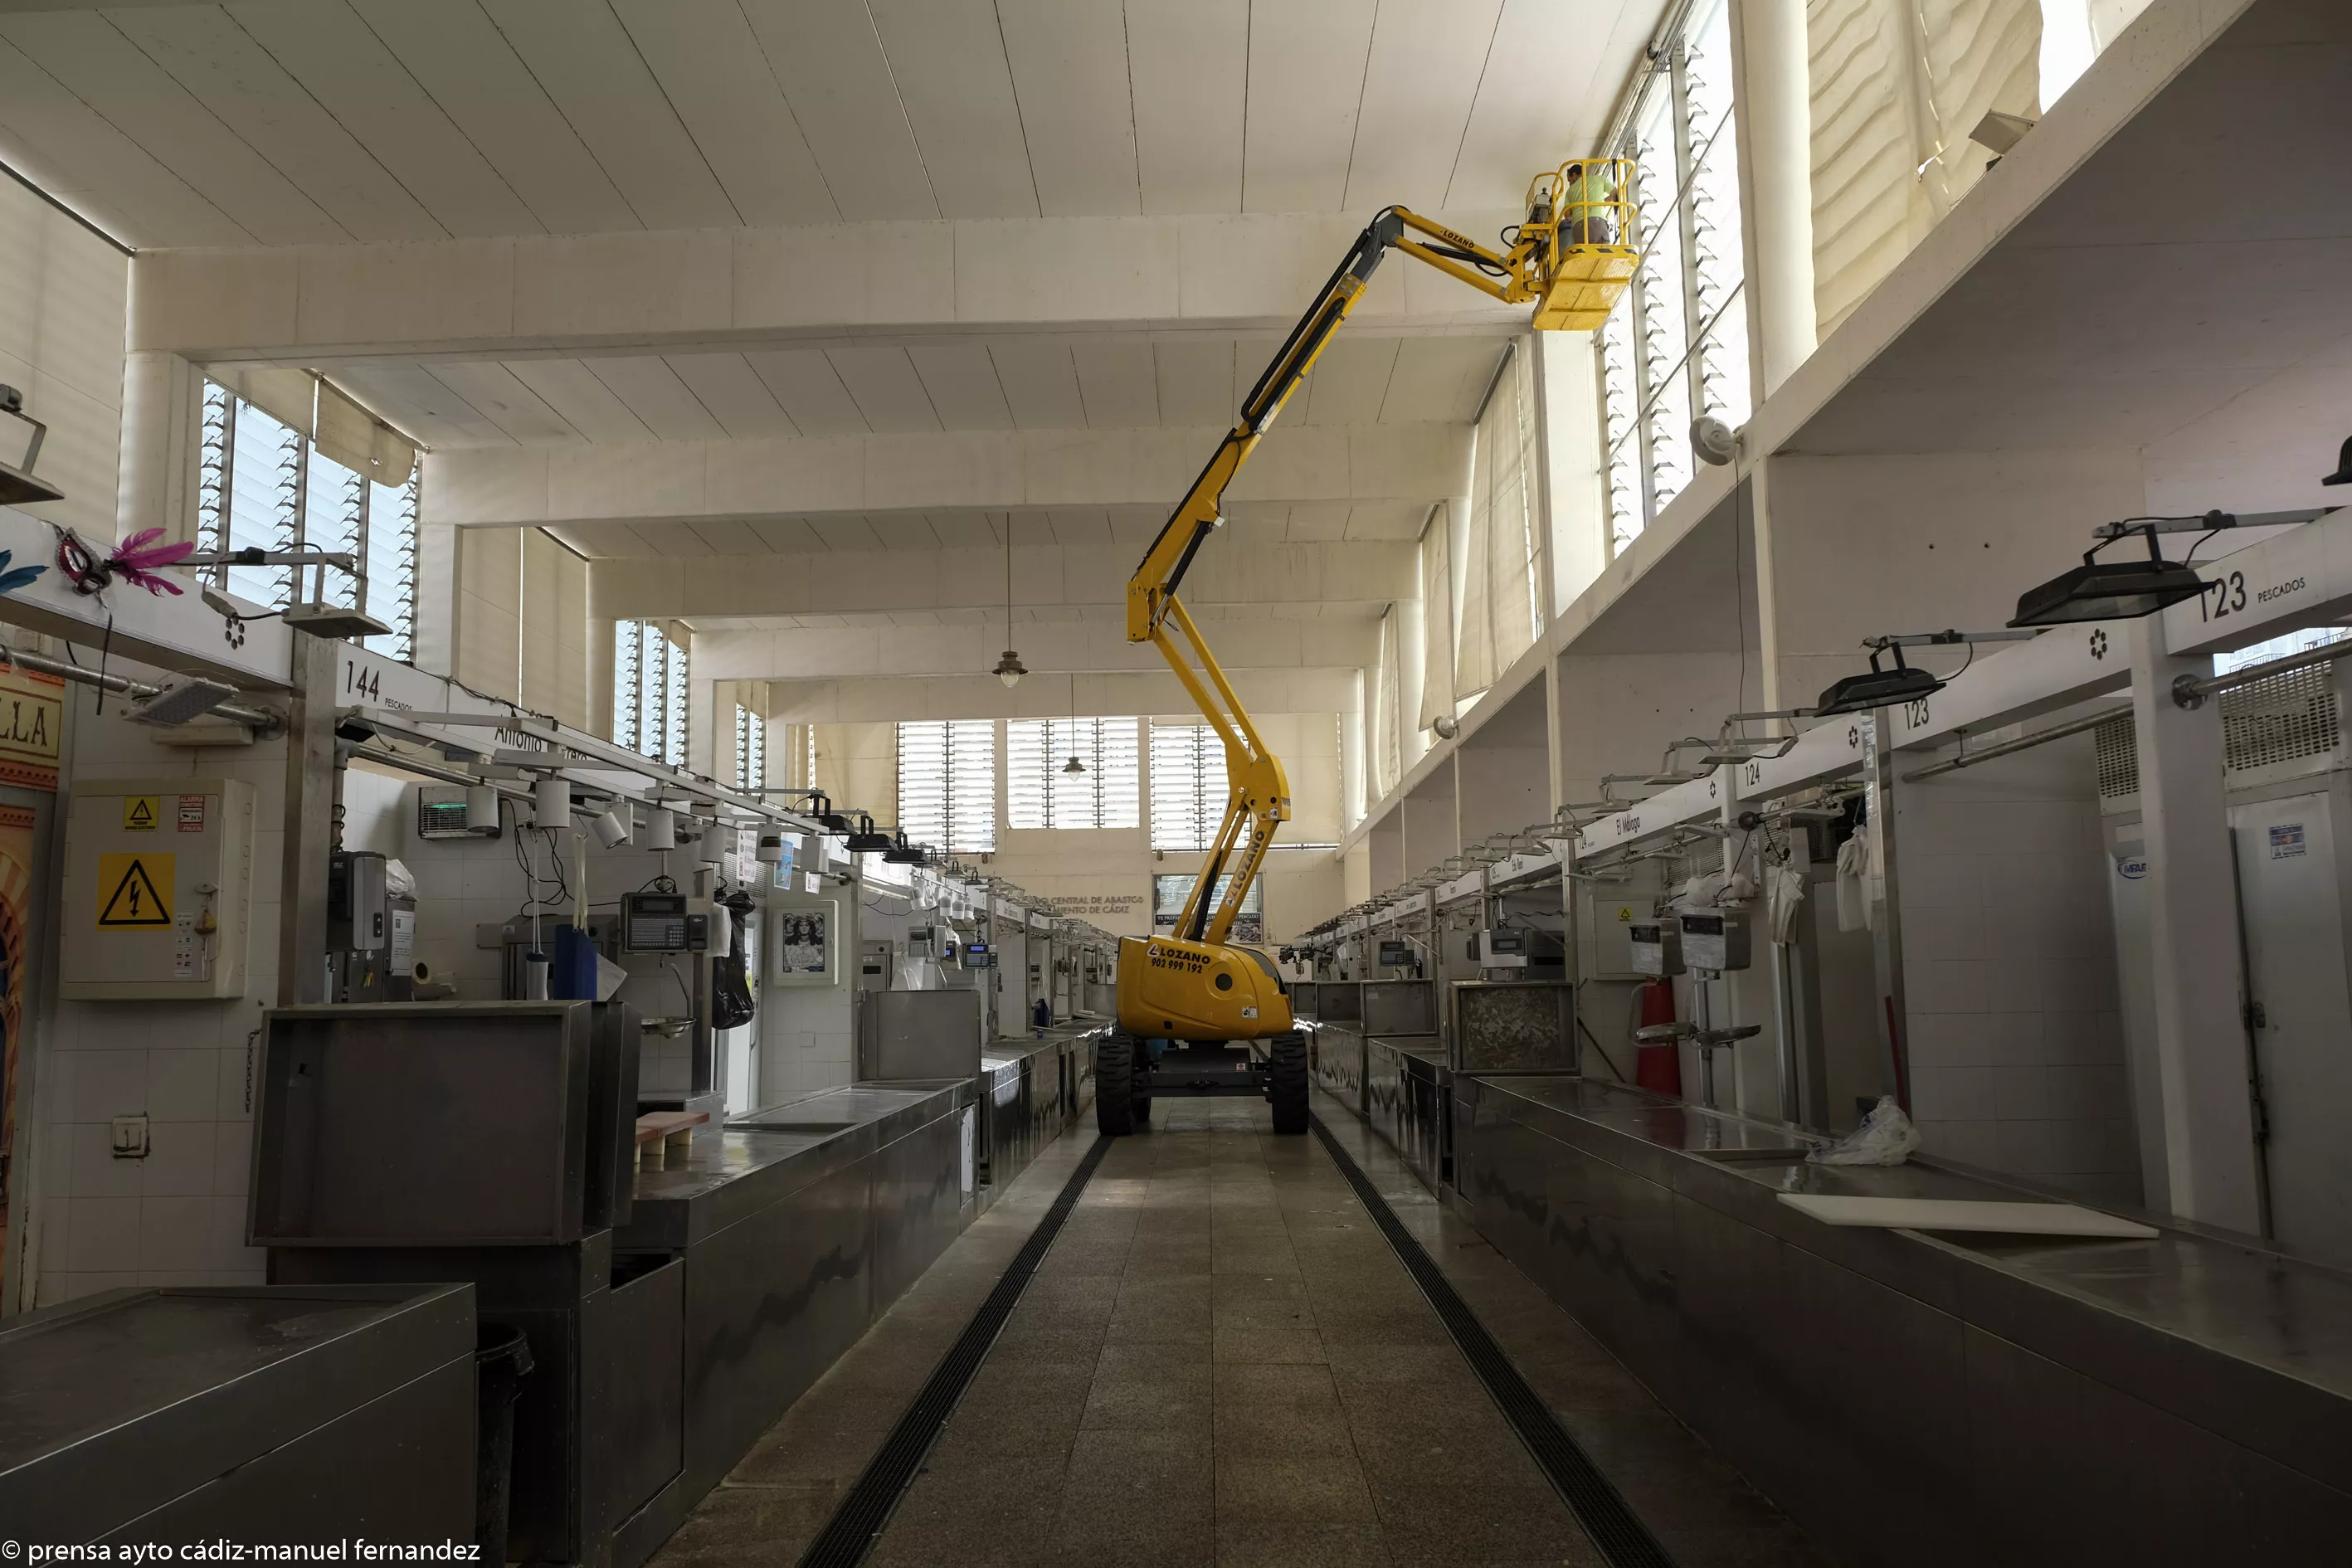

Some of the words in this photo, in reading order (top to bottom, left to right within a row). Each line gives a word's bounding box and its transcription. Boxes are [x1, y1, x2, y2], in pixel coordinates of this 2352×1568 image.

[1444, 230, 1474, 248] LOZANO
[2201, 571, 2247, 623] 123
[2258, 577, 2306, 604] PESCADOS
[348, 660, 380, 702] 144
[384, 698, 412, 711] PESCADOS
[1903, 698, 1930, 730] 123
[1745, 762, 1760, 786] 124
[1233, 830, 1265, 890] LOZANO
[1050, 896, 1088, 905] CENTRAL
[1091, 896, 1103, 904] DE
[1104, 896, 1144, 904] ABASTOS
[1103, 903, 1130, 913] CÁDIZ
[1152, 957, 1166, 968] 902
[1168, 961, 1185, 971] 999
[1186, 963, 1203, 974] 192
[1160, 948, 1210, 964] LOZANO
